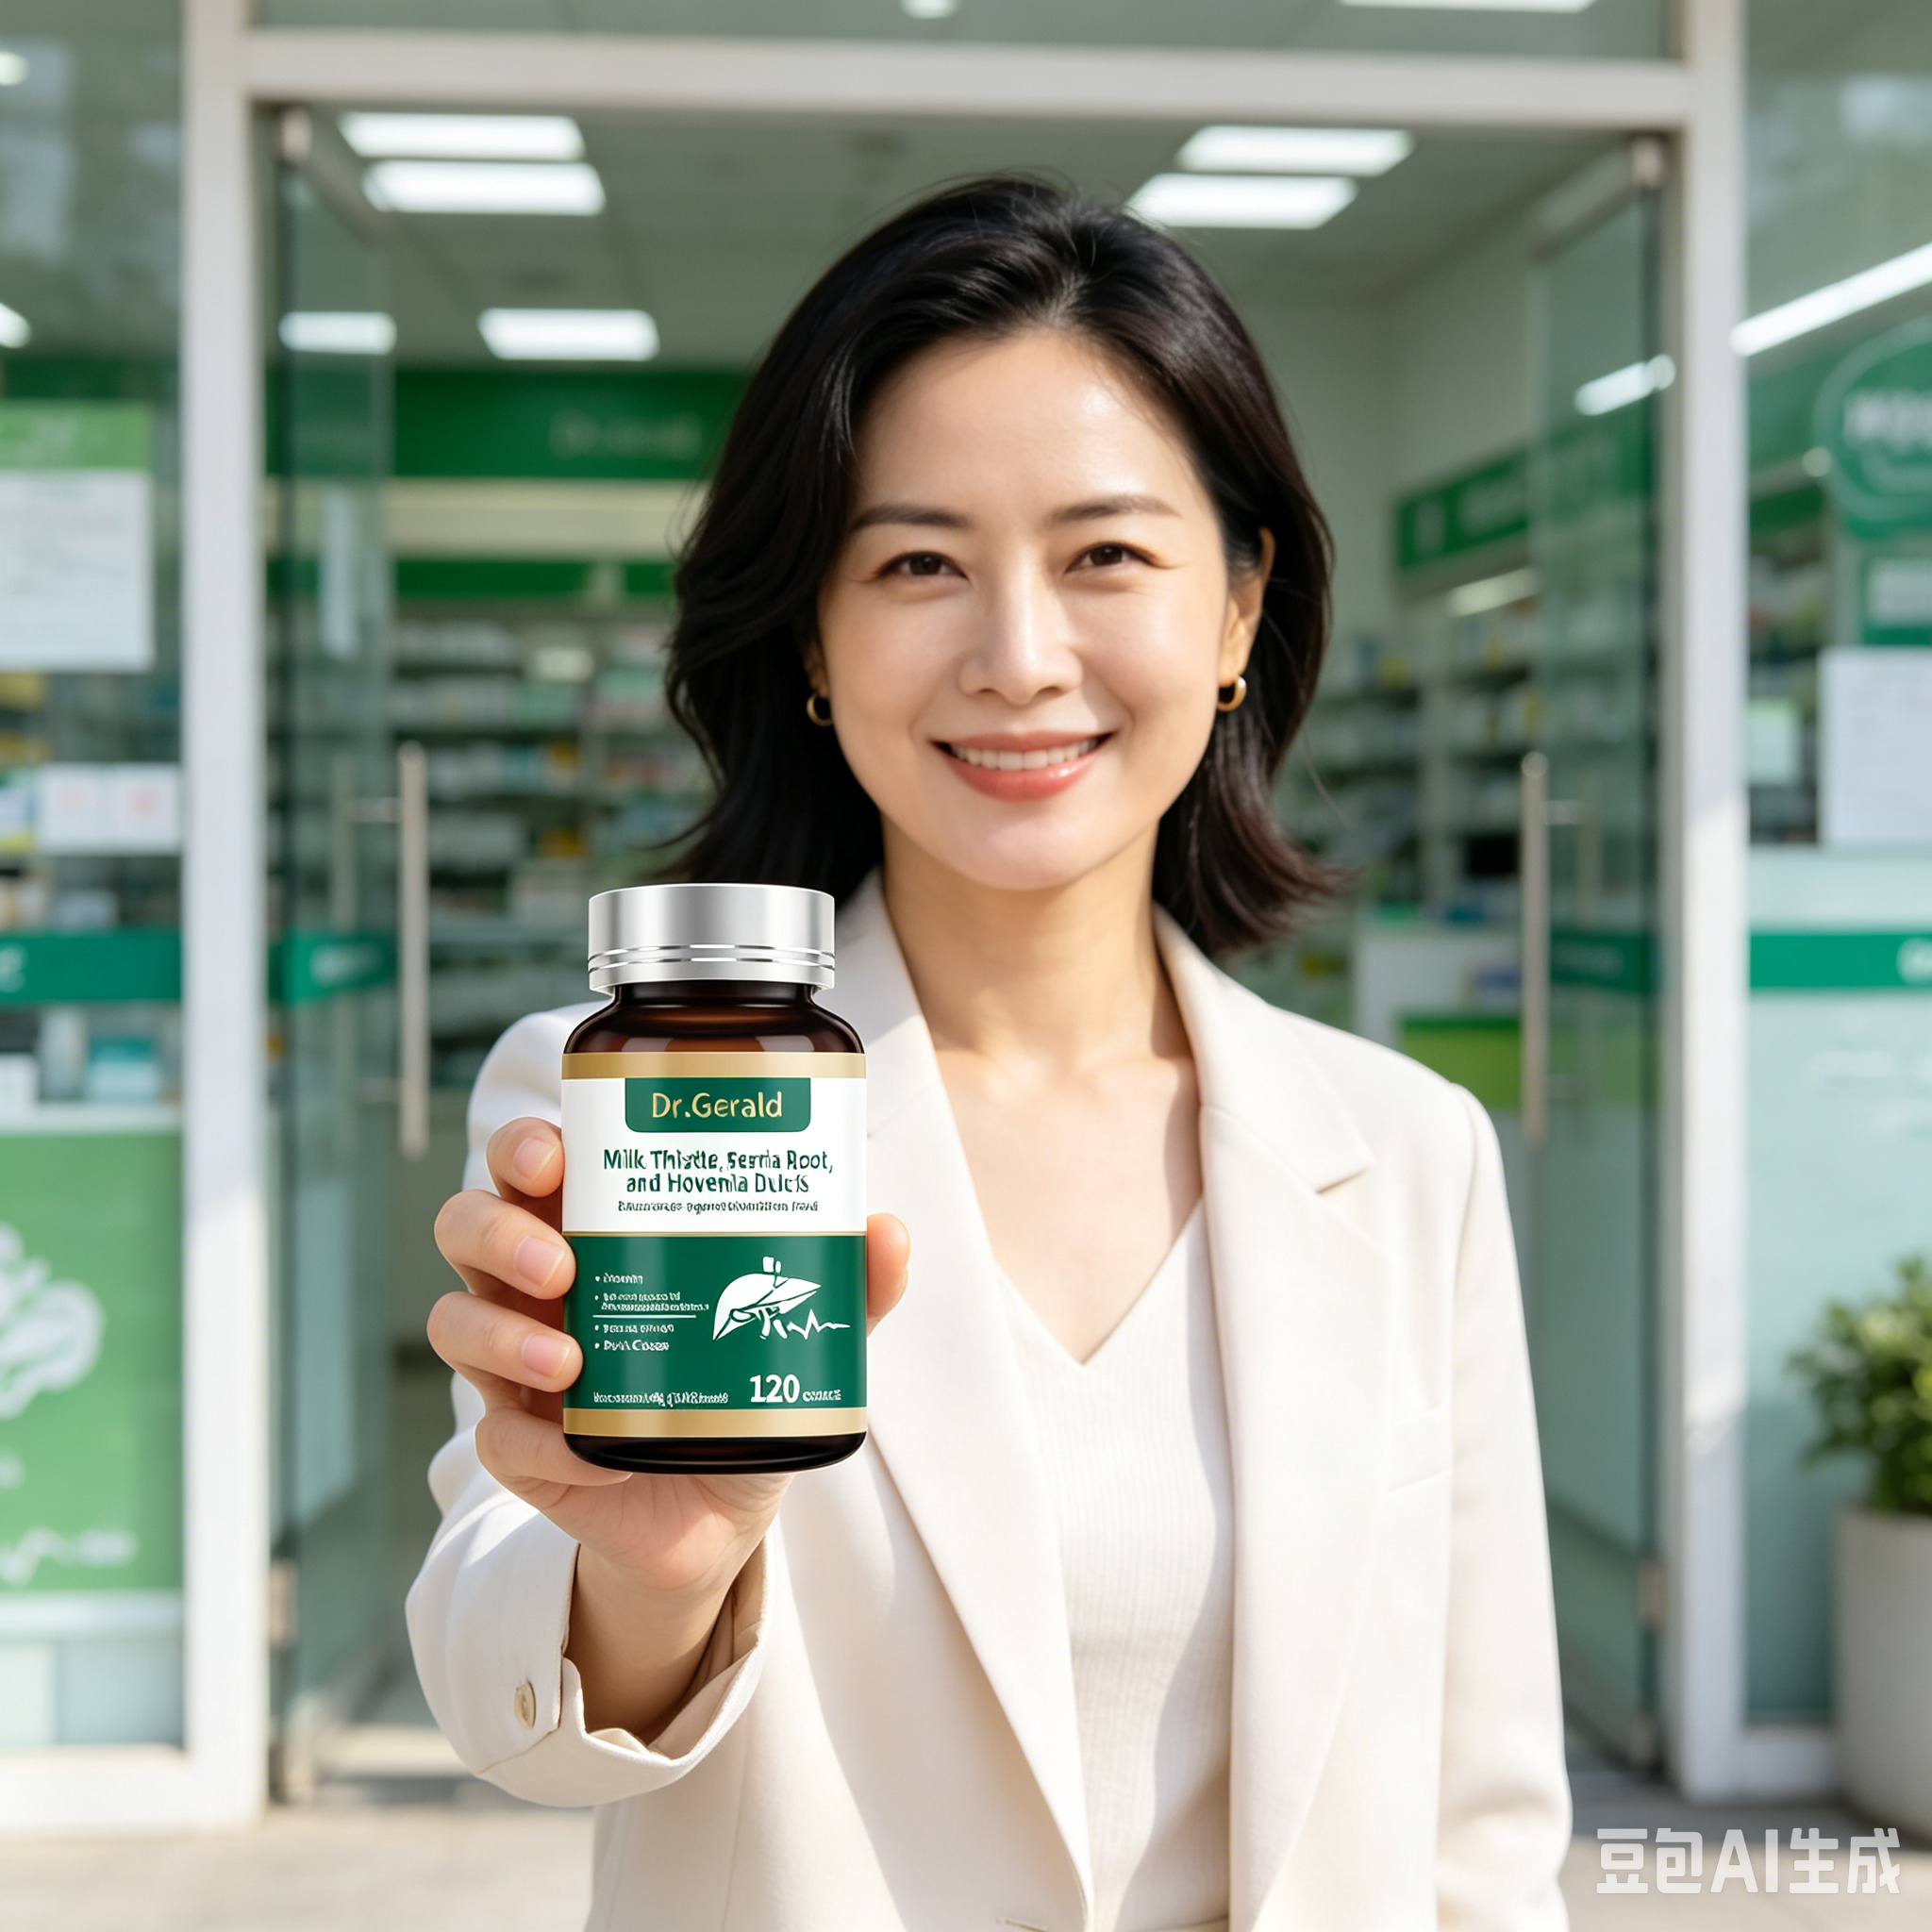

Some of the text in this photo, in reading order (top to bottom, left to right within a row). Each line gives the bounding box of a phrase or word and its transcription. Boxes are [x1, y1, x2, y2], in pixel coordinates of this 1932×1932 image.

[652, 1091, 782, 1118] Dr.Gerald
[604, 1149, 646, 1170] Milk
[787, 1149, 833, 1174] Root,
[626, 1173, 660, 1192] and
[749, 1374, 801, 1404] 120
